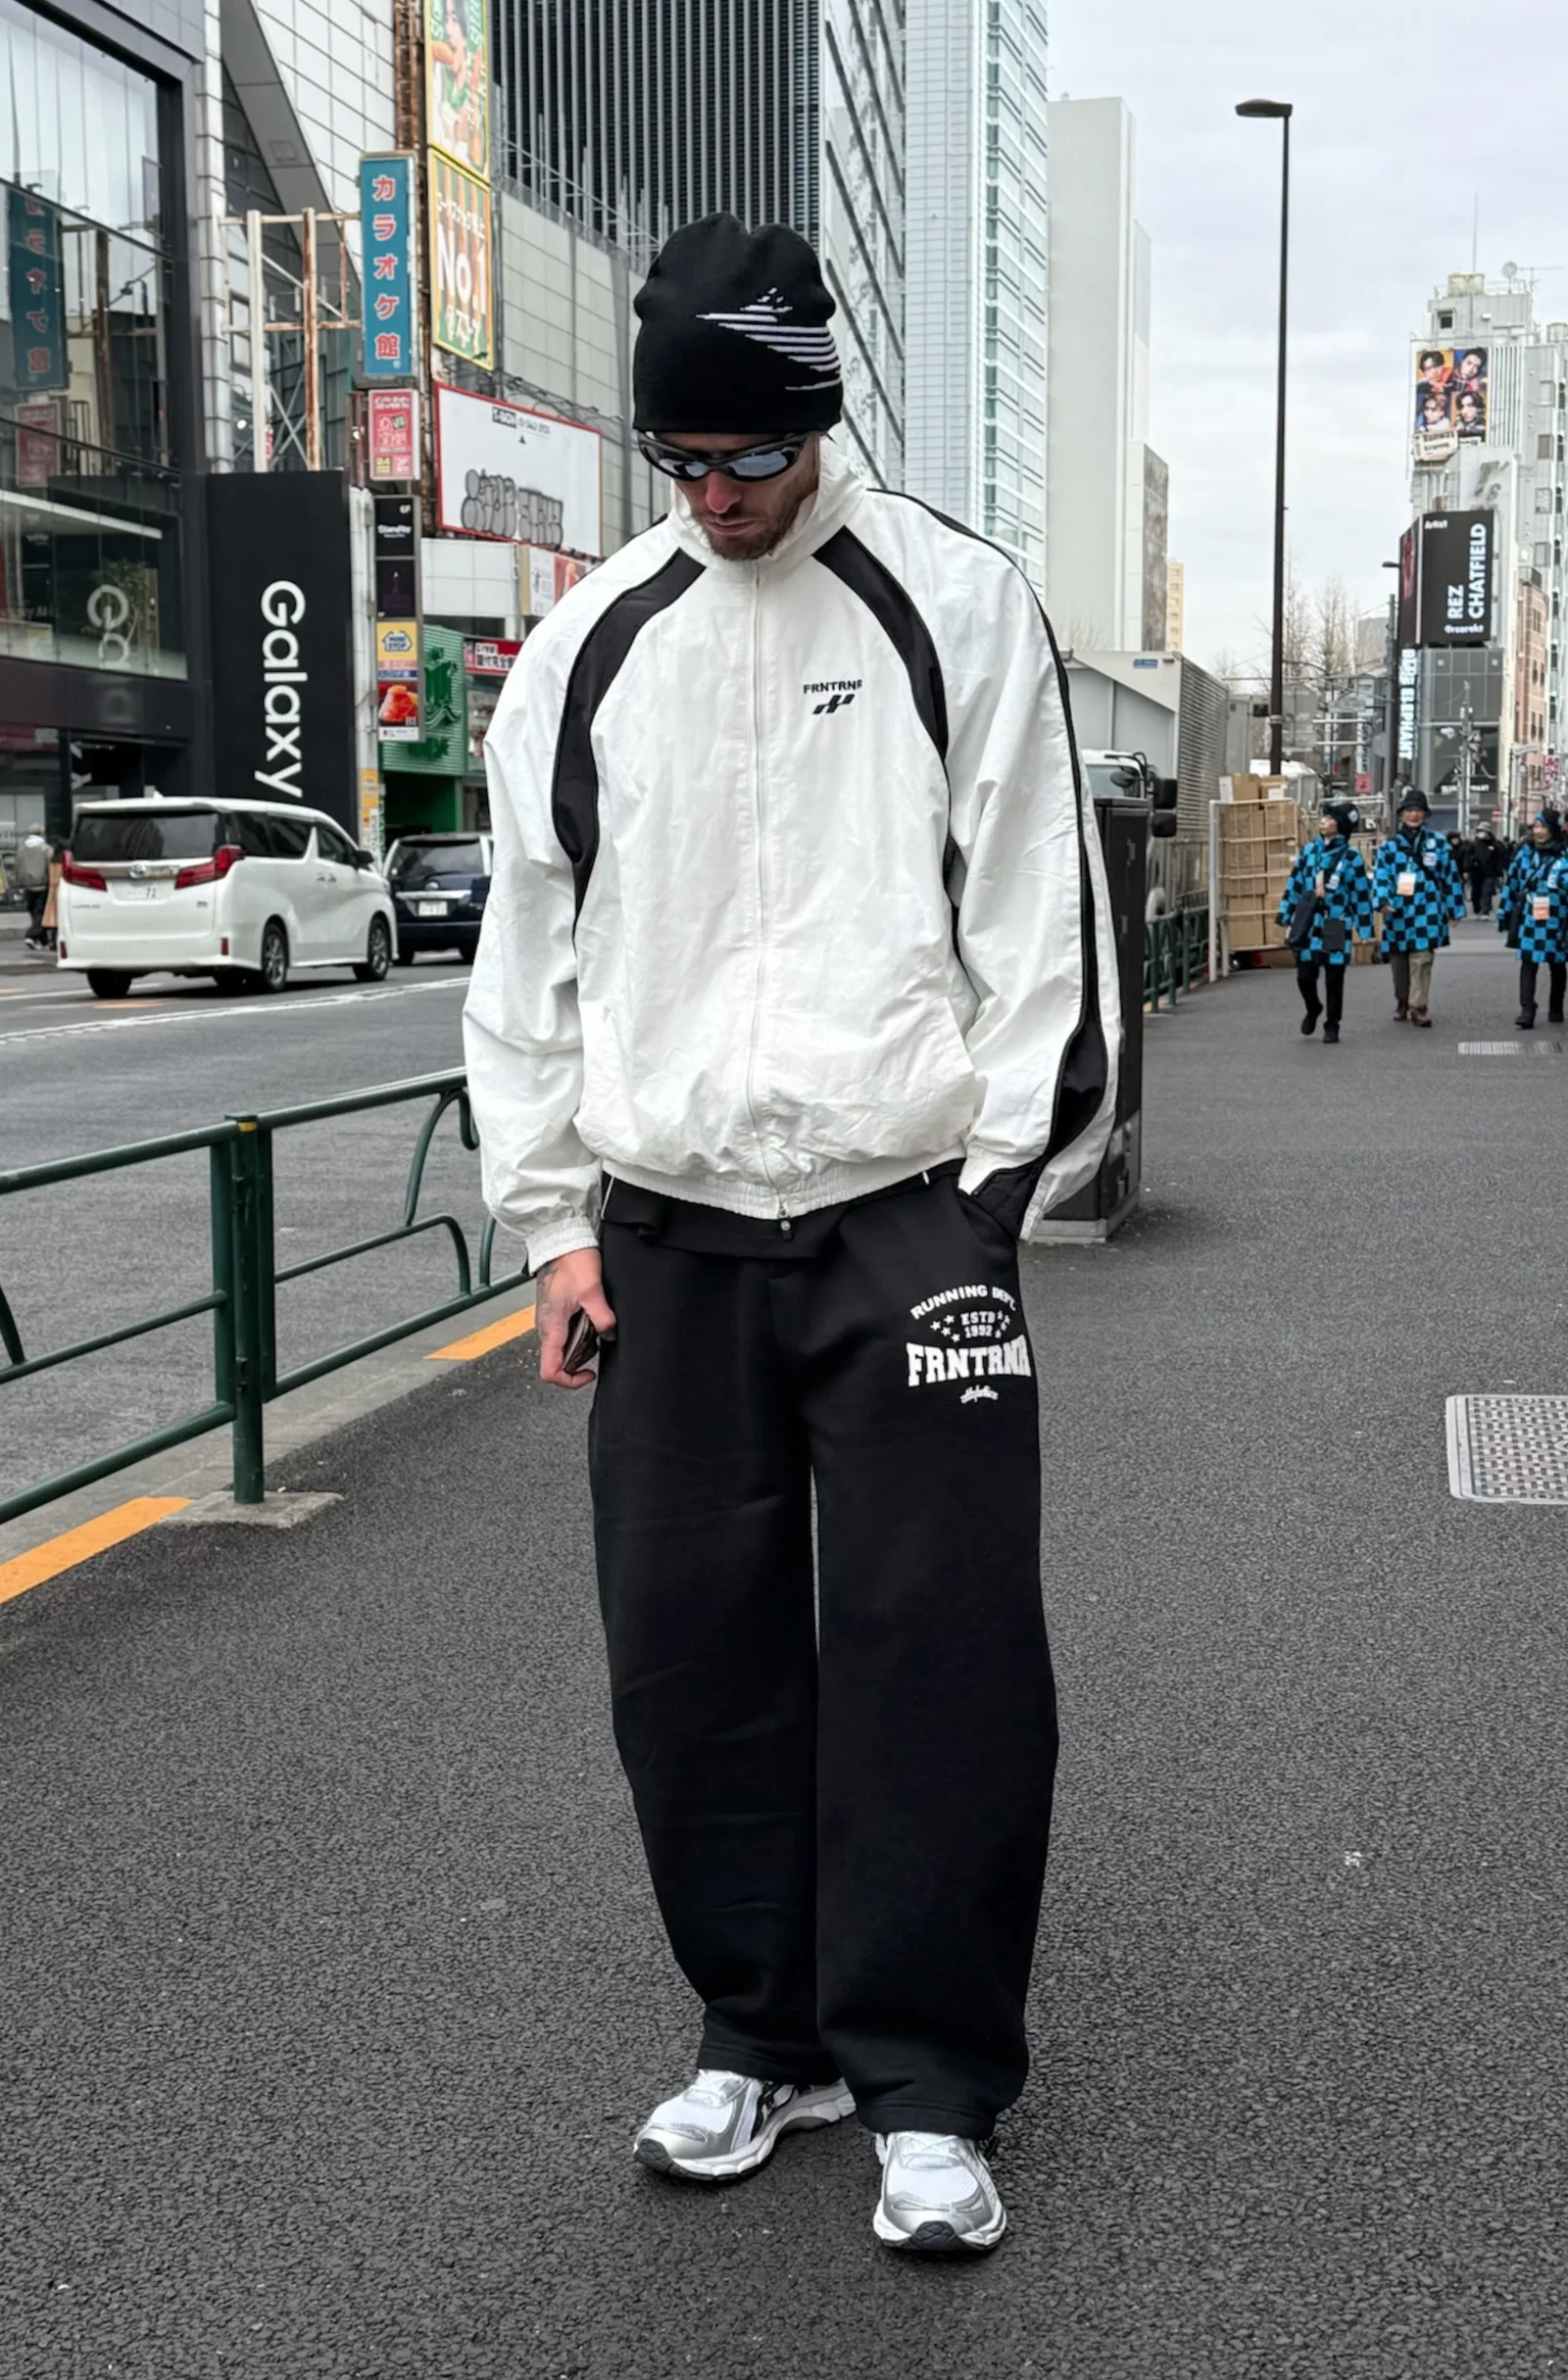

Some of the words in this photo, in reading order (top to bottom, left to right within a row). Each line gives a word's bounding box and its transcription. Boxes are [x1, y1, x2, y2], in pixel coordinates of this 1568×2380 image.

[372, 174, 401, 361] カラオケ館
[437, 221, 487, 316] No.1
[1446, 584, 1464, 619] REZ
[1467, 522, 1487, 619] CHATFIELD
[254, 580, 309, 799] Galaxy
[910, 1285, 988, 1320] RUNNING
[960, 1311, 996, 1326] ESTD
[964, 1325, 994, 1339] 1992
